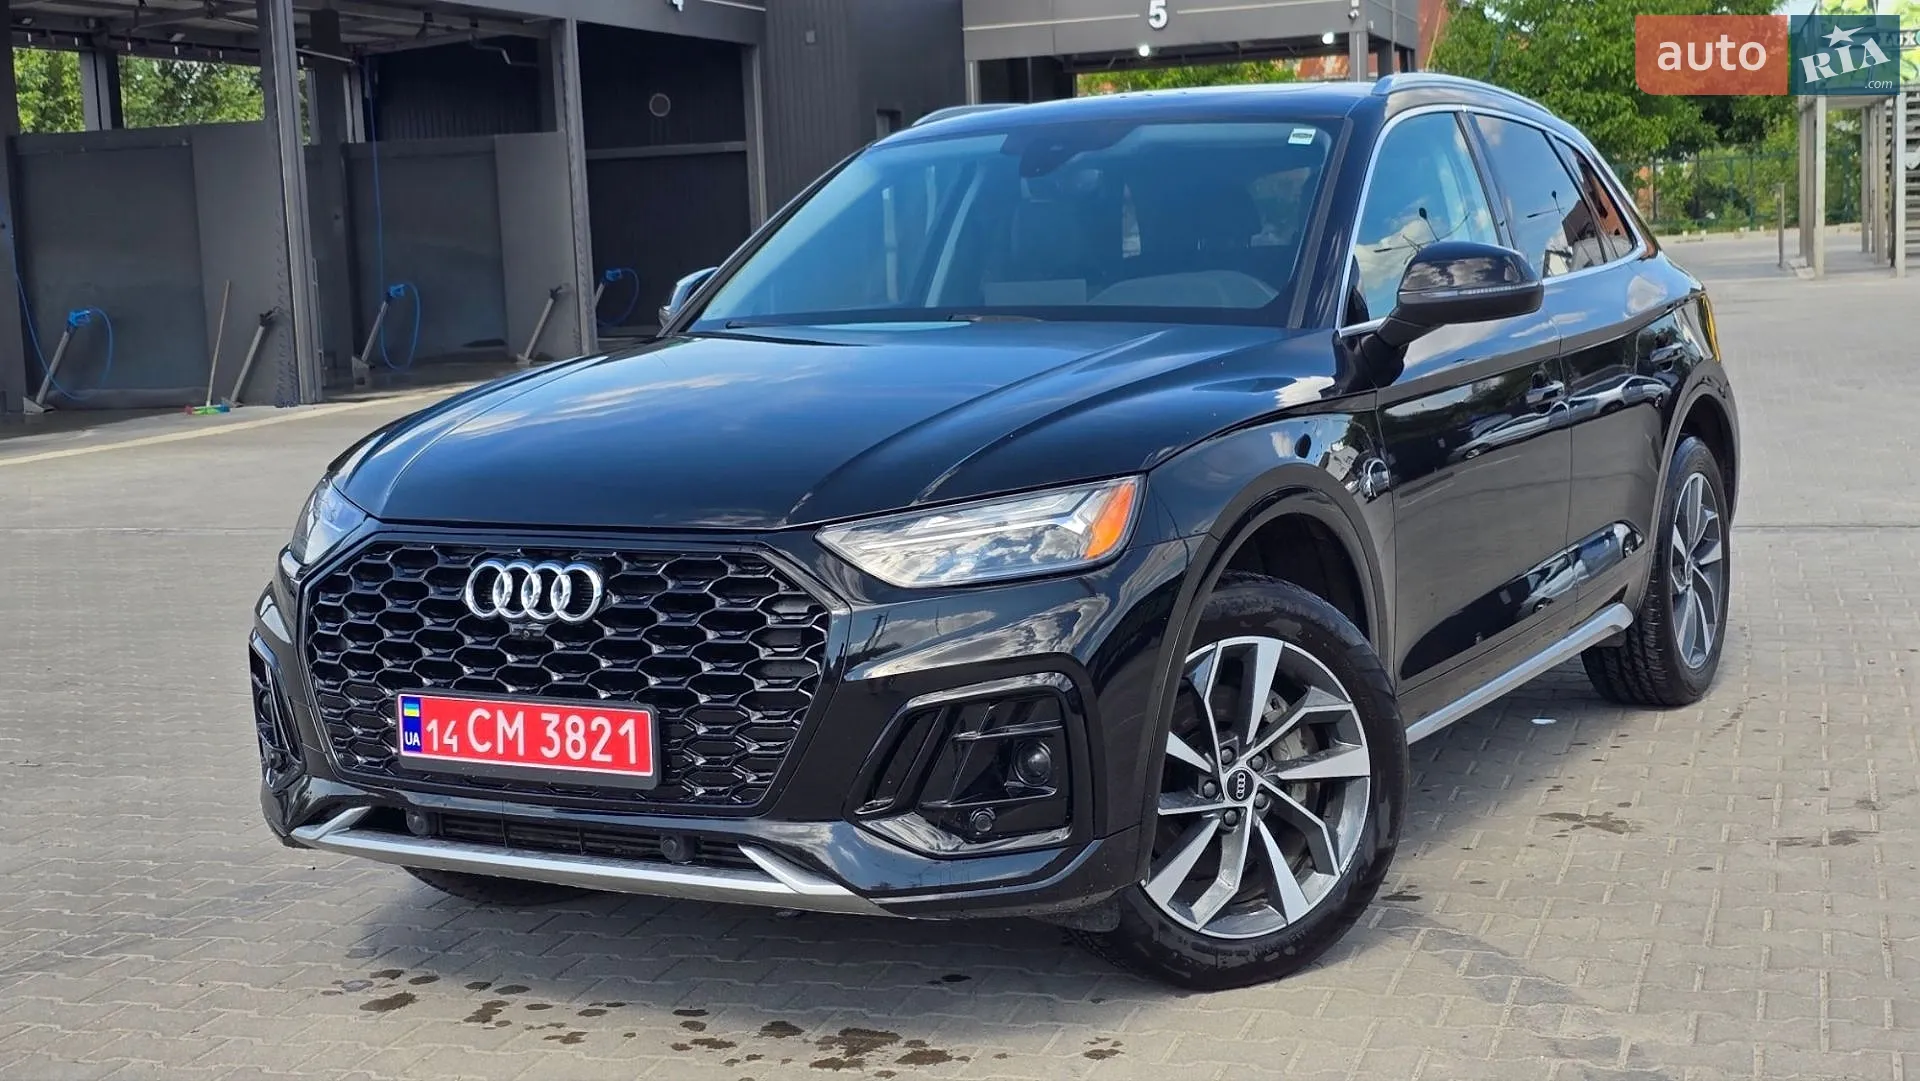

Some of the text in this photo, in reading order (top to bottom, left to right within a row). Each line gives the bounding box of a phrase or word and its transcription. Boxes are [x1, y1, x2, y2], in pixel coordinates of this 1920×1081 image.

[1148, 0, 1168, 29] 5
[404, 731, 421, 746] UA
[426, 708, 637, 764] 14 CM 3821
